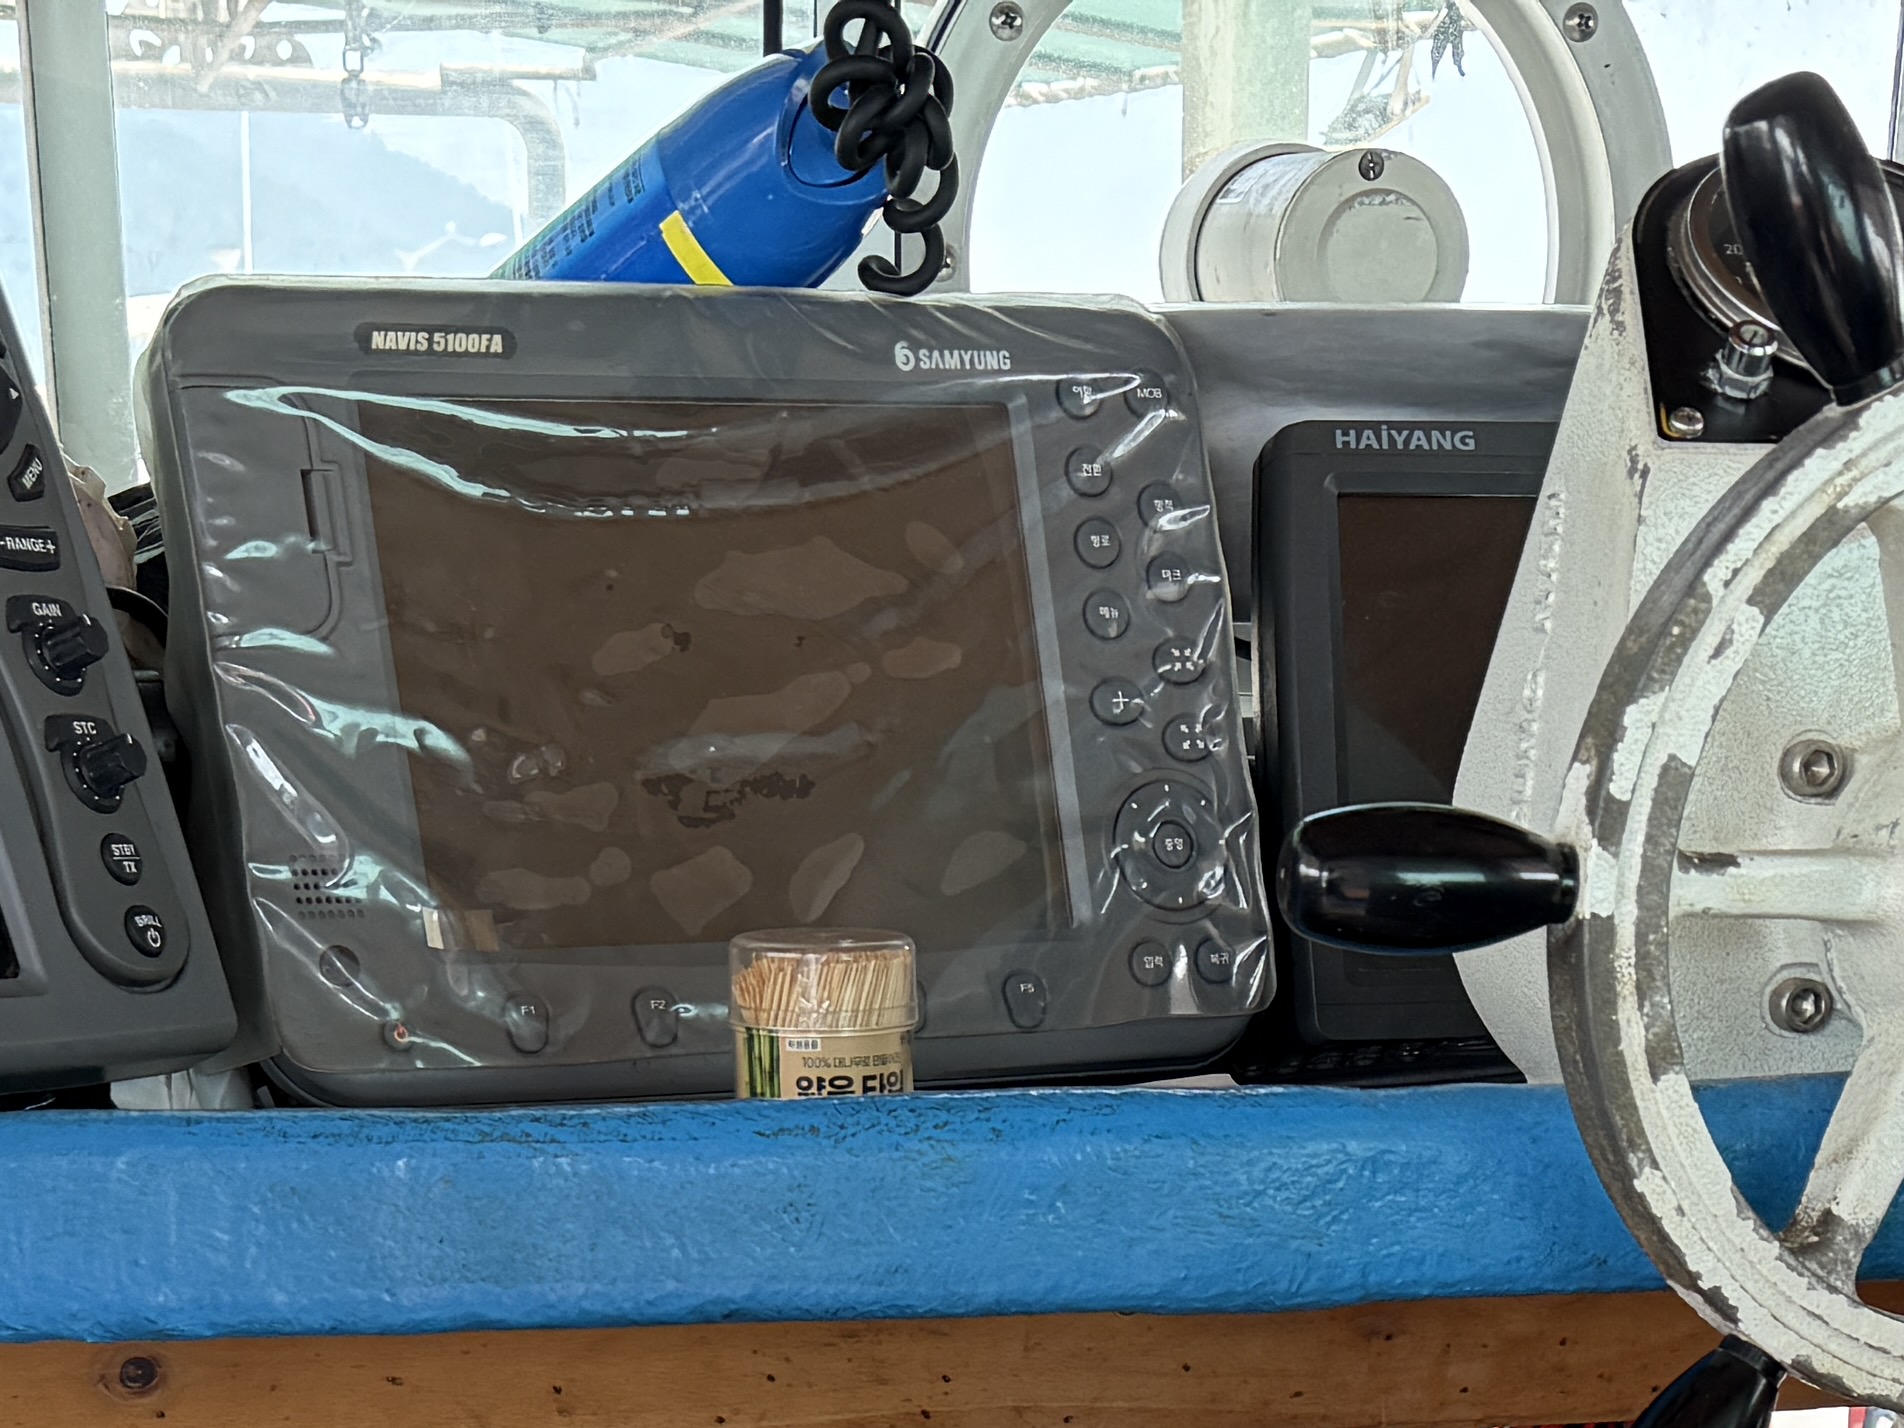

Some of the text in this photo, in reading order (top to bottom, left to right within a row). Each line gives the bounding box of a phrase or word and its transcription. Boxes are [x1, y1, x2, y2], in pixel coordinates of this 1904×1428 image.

[371, 329, 505, 357] NAVIS 5100FA
[918, 347, 1012, 373] SAMYUNG
[1136, 387, 1163, 400] MOB
[21, 457, 44, 489] MENU
[32, 602, 62, 617] GAIN
[72, 720, 97, 736] STC
[122, 861, 138, 874] TX
[520, 1004, 537, 1015] F1
[649, 999, 667, 1010] F2
[801, 1056, 832, 1068] 100%
